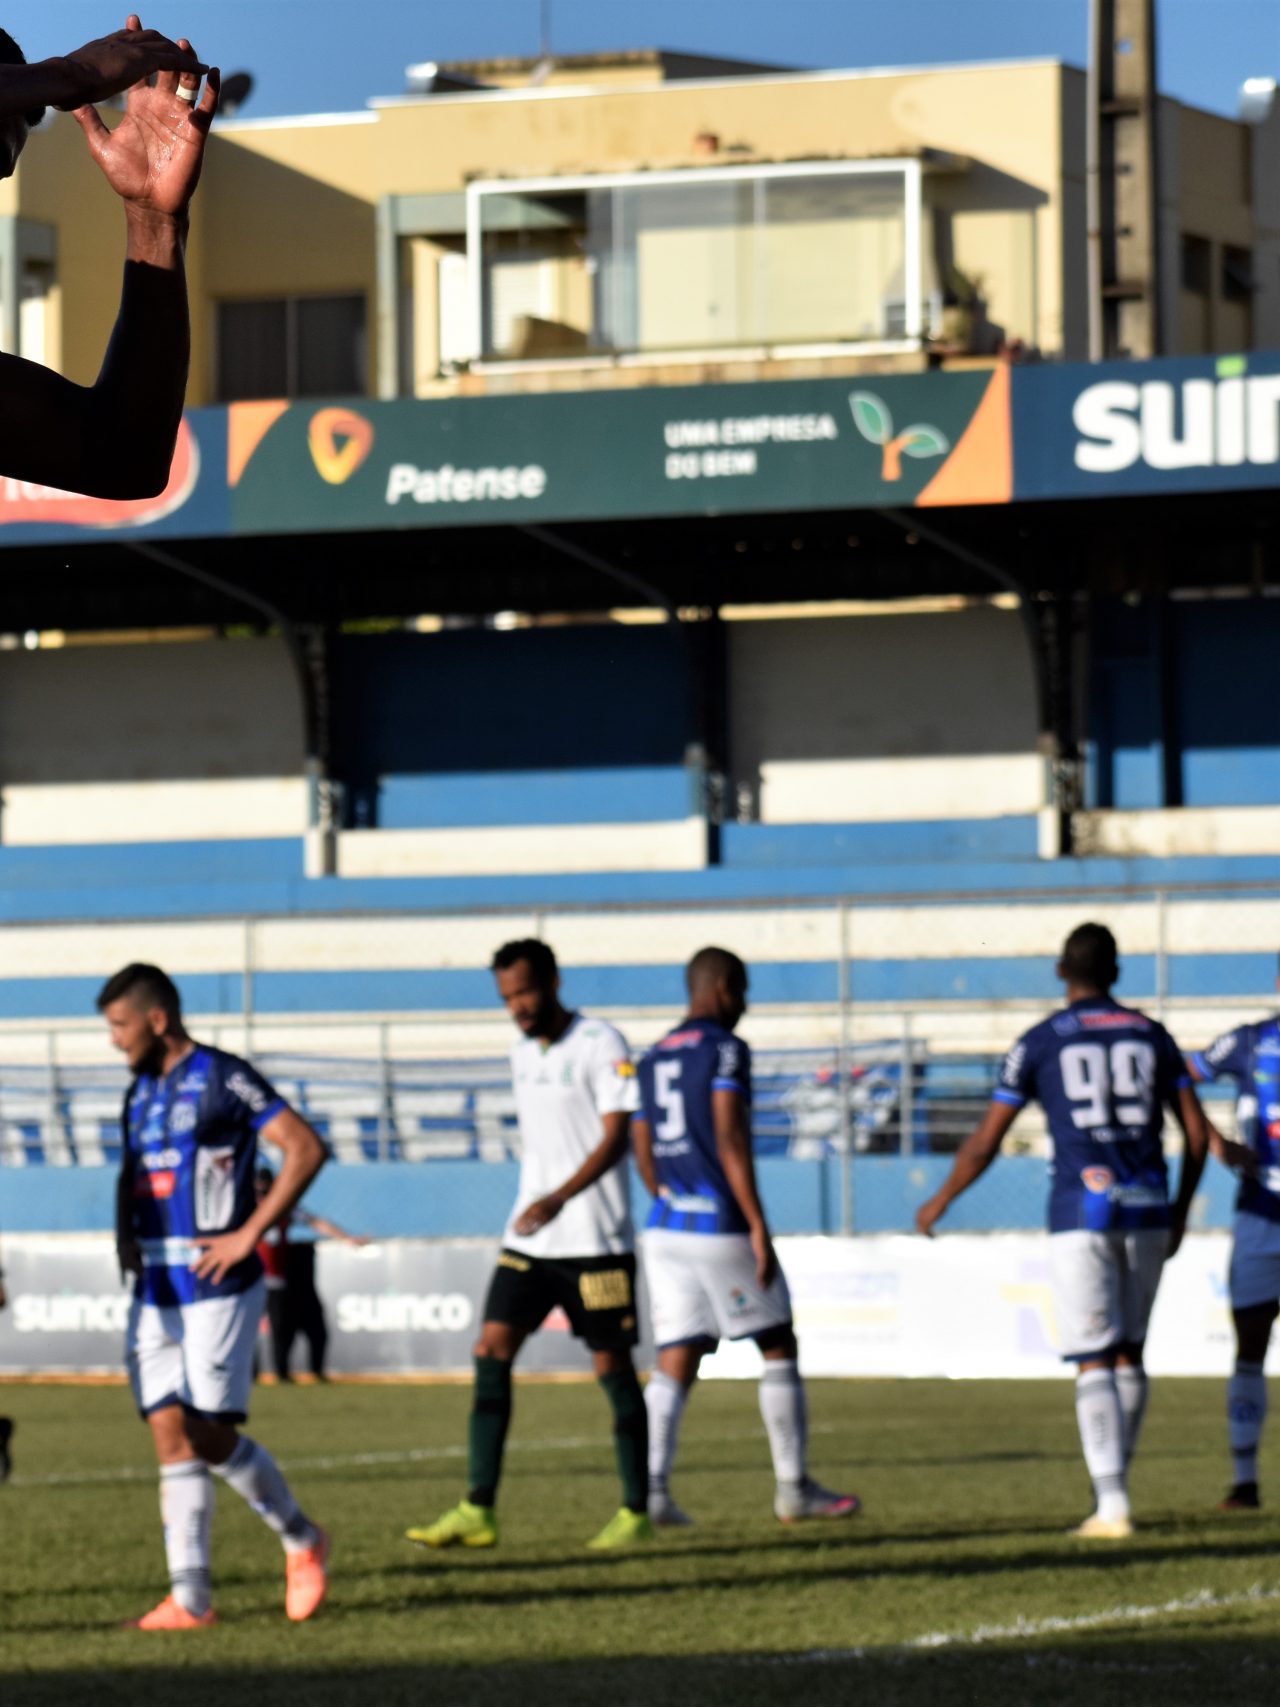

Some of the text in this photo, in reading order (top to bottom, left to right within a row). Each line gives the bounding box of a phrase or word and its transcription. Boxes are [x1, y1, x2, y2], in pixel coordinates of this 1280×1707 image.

[664, 413, 838, 448] UMA EMPRESA
[385, 462, 547, 505] Patense
[702, 449, 757, 477] BEM
[654, 1061, 687, 1141] 5
[1059, 1040, 1156, 1129] 99
[337, 1289, 472, 1332] suinco
